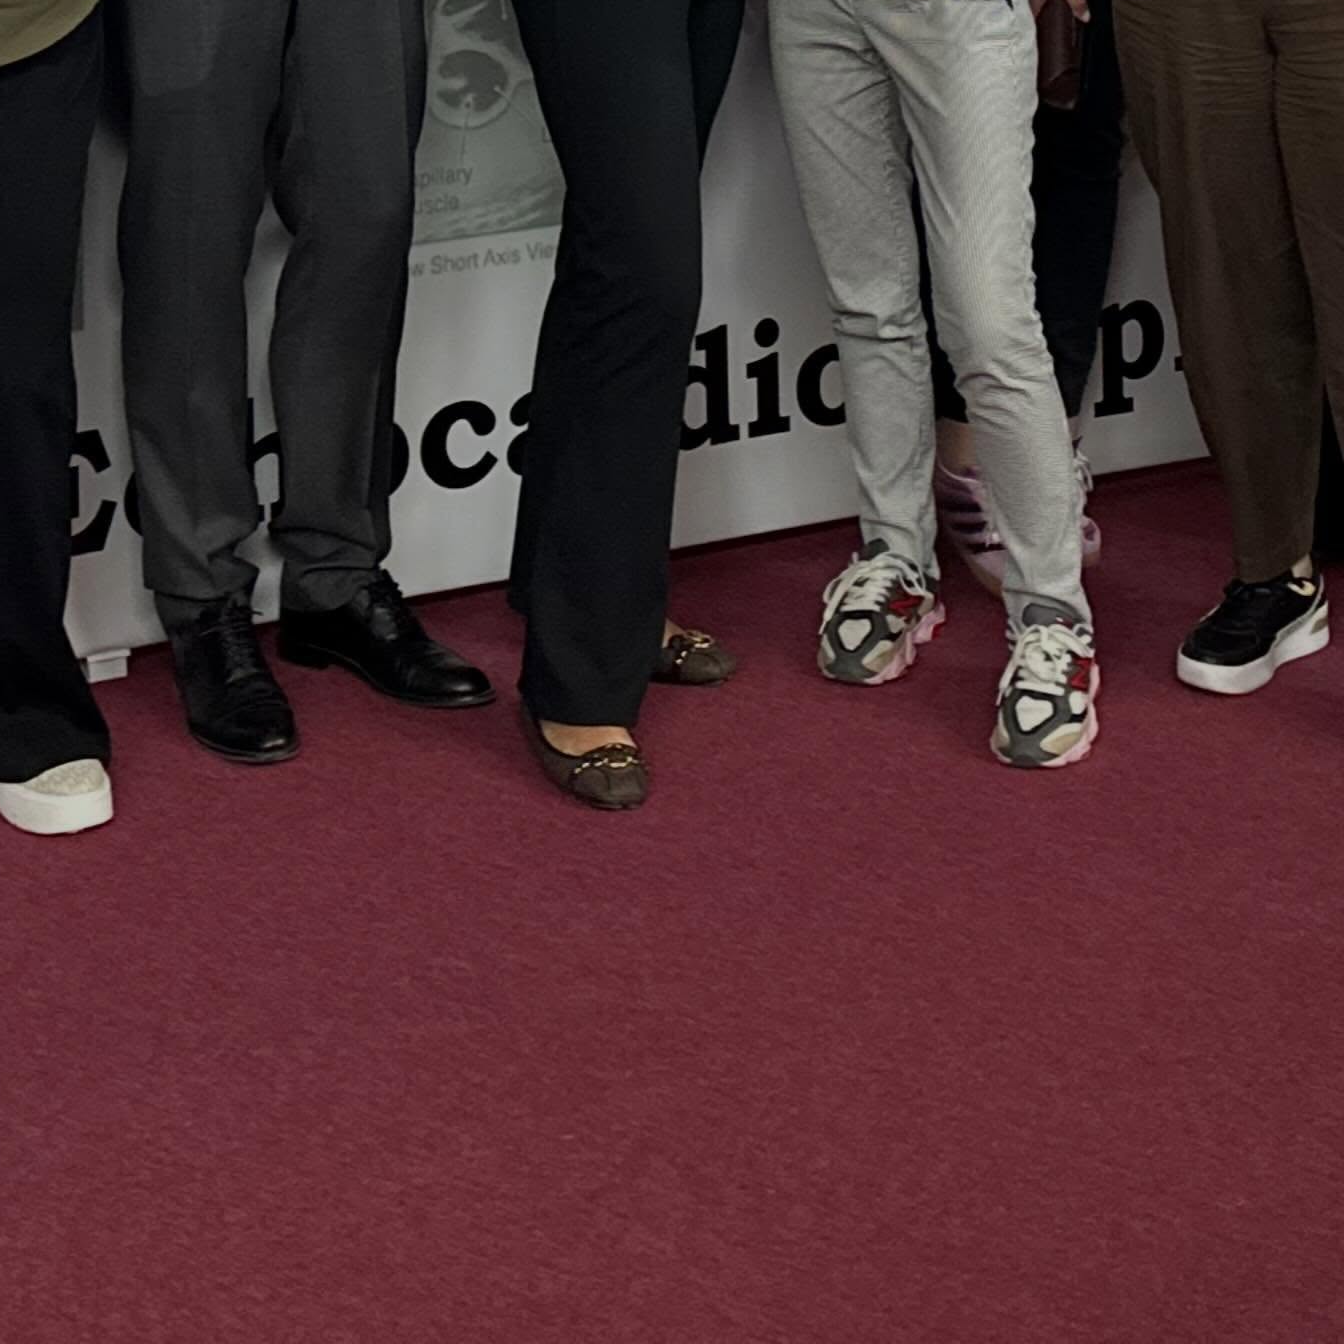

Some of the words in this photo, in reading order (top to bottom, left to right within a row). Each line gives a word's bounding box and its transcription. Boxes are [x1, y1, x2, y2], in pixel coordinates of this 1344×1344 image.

[414, 166, 473, 189] pillary
[430, 251, 480, 275] Short
[483, 247, 521, 268] Axis
[525, 241, 555, 261] Vie
